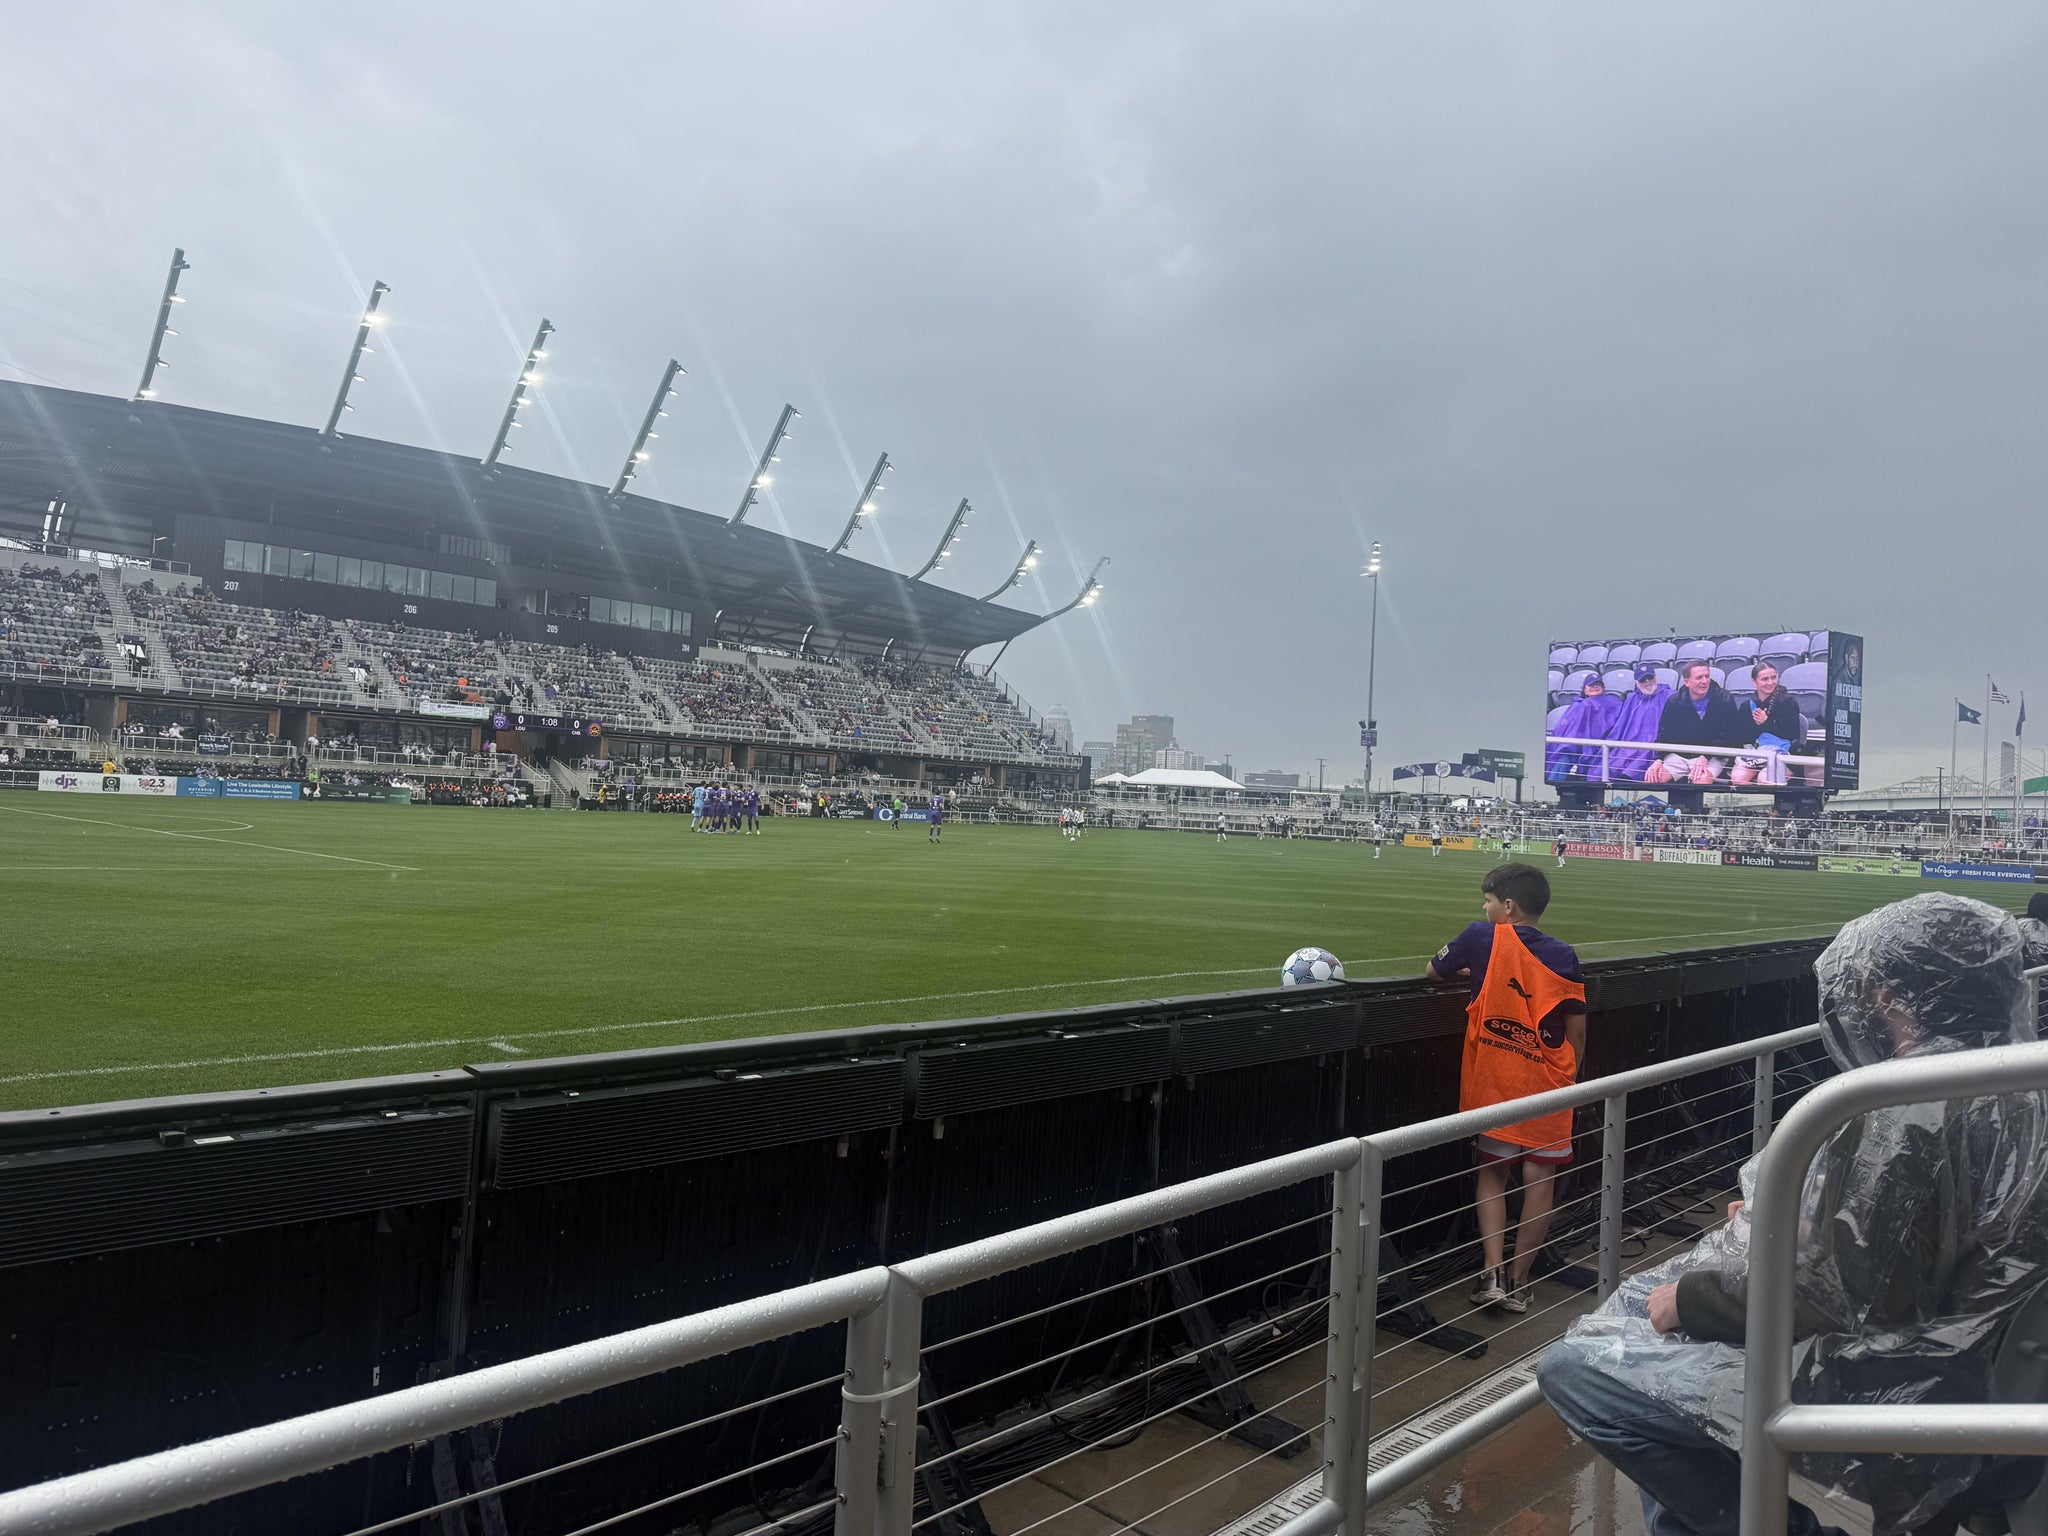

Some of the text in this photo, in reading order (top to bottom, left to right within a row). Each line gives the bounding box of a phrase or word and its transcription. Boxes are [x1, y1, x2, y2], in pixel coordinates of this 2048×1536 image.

[224, 581, 239, 590] 207
[404, 604, 417, 614] 206
[547, 624, 558, 634] 205
[518, 715, 579, 729] 0 1:08 0
[1835, 750, 1855, 766] APRIL 12
[54, 775, 78, 789] djx
[914, 812, 927, 820] Bank
[1566, 843, 1622, 853] JEFFERSON
[1659, 851, 1687, 863] BUFFALO
[1696, 852, 1717, 864] TRACE
[1742, 855, 1775, 866] Health
[1934, 865, 1959, 877] Kroger
